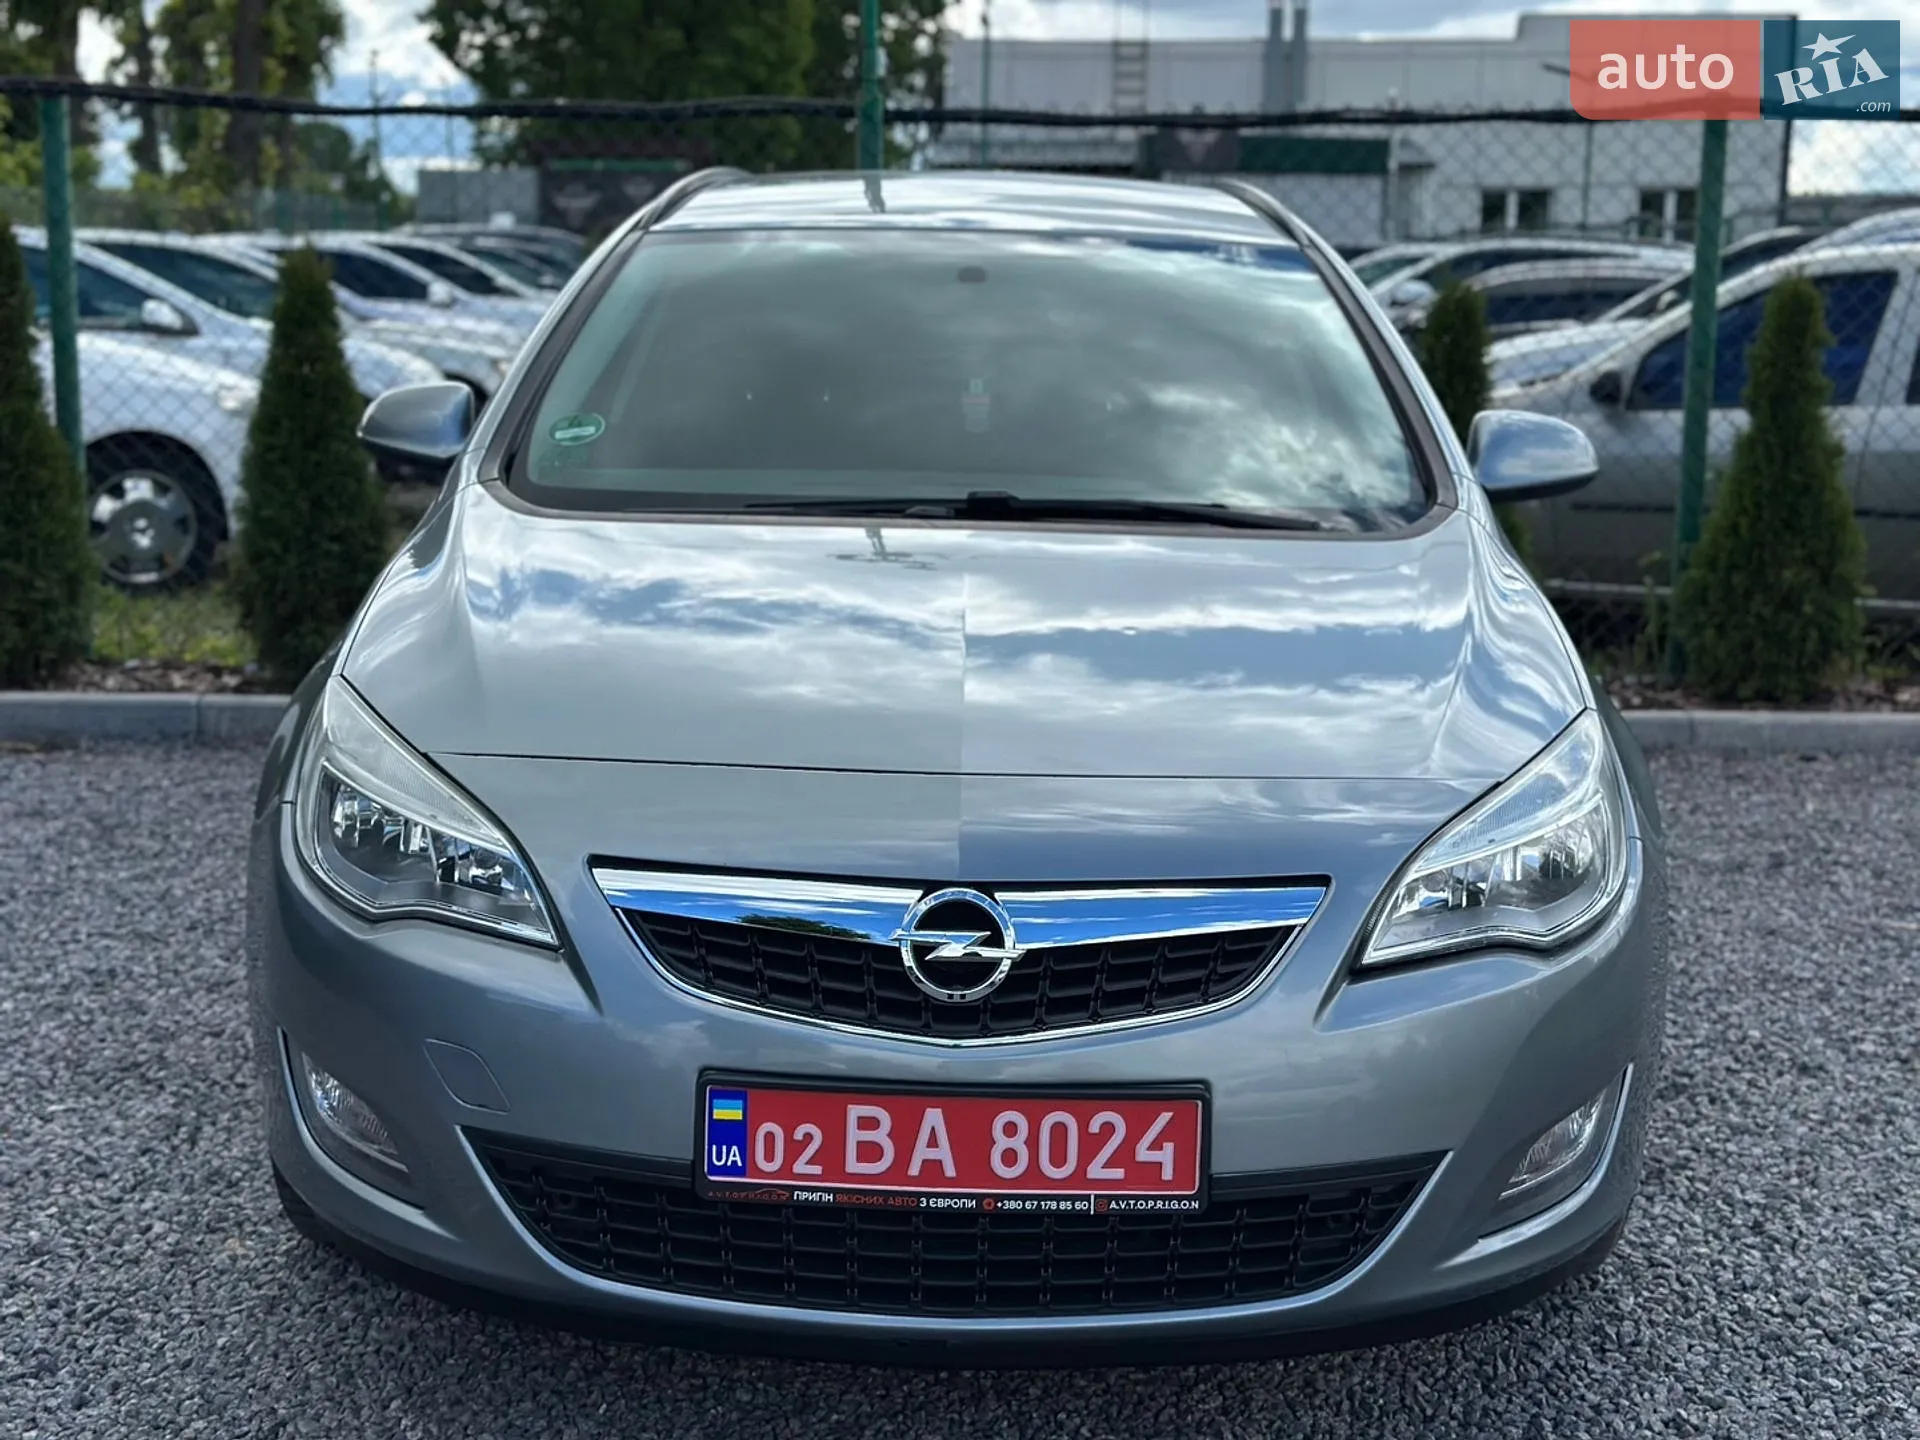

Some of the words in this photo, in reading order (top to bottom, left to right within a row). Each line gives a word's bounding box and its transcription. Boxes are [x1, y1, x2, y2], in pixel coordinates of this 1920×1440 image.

[754, 1122, 823, 1176] 02
[845, 1104, 956, 1178] BA
[990, 1110, 1174, 1181] 8024
[712, 1145, 743, 1168] UA
[888, 1196, 918, 1207] АВТО
[930, 1198, 976, 1209] ЄВРОПИ
[997, 1200, 1023, 1210] +380
[1025, 1200, 1038, 1210] 67
[1041, 1200, 1057, 1210] 178
[1059, 1201, 1072, 1210] 85
[1074, 1201, 1089, 1210] 60
